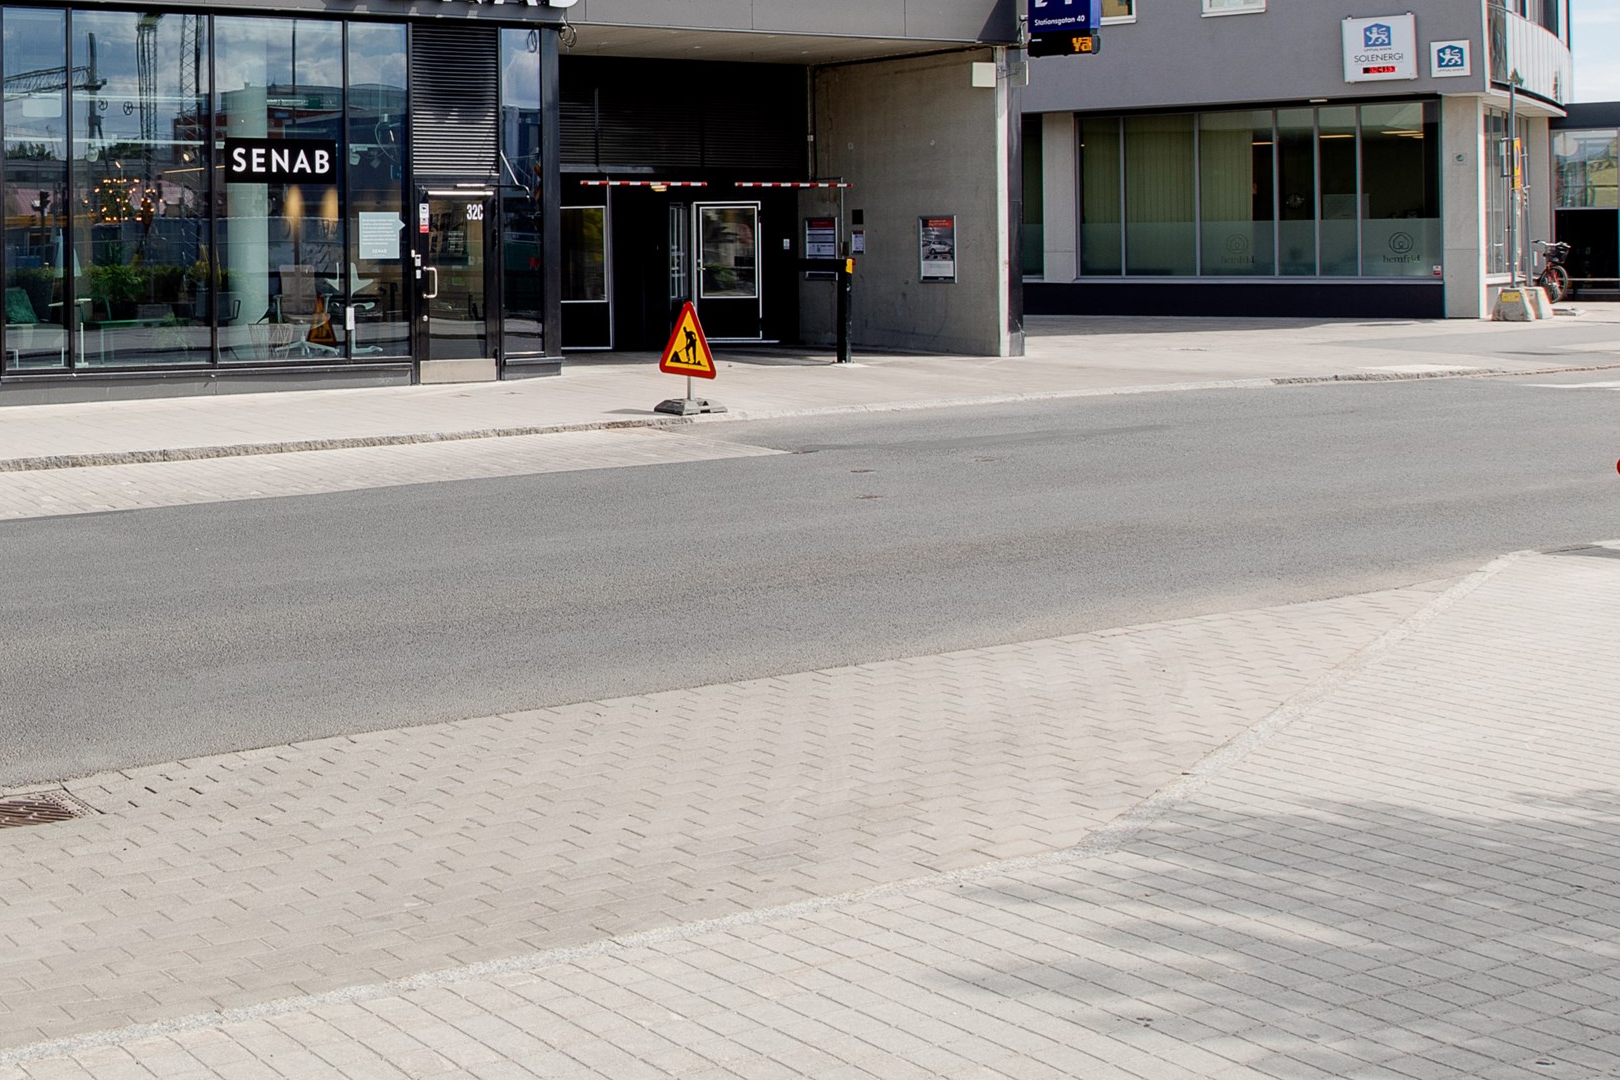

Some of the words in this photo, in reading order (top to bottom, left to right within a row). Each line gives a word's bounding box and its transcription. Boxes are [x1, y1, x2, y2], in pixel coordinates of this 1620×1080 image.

[1034, 17, 1075, 26] Stationsgatan
[1353, 53, 1403, 63] SOLENERGI
[232, 147, 330, 174] SENAB
[466, 204, 483, 220] 32C
